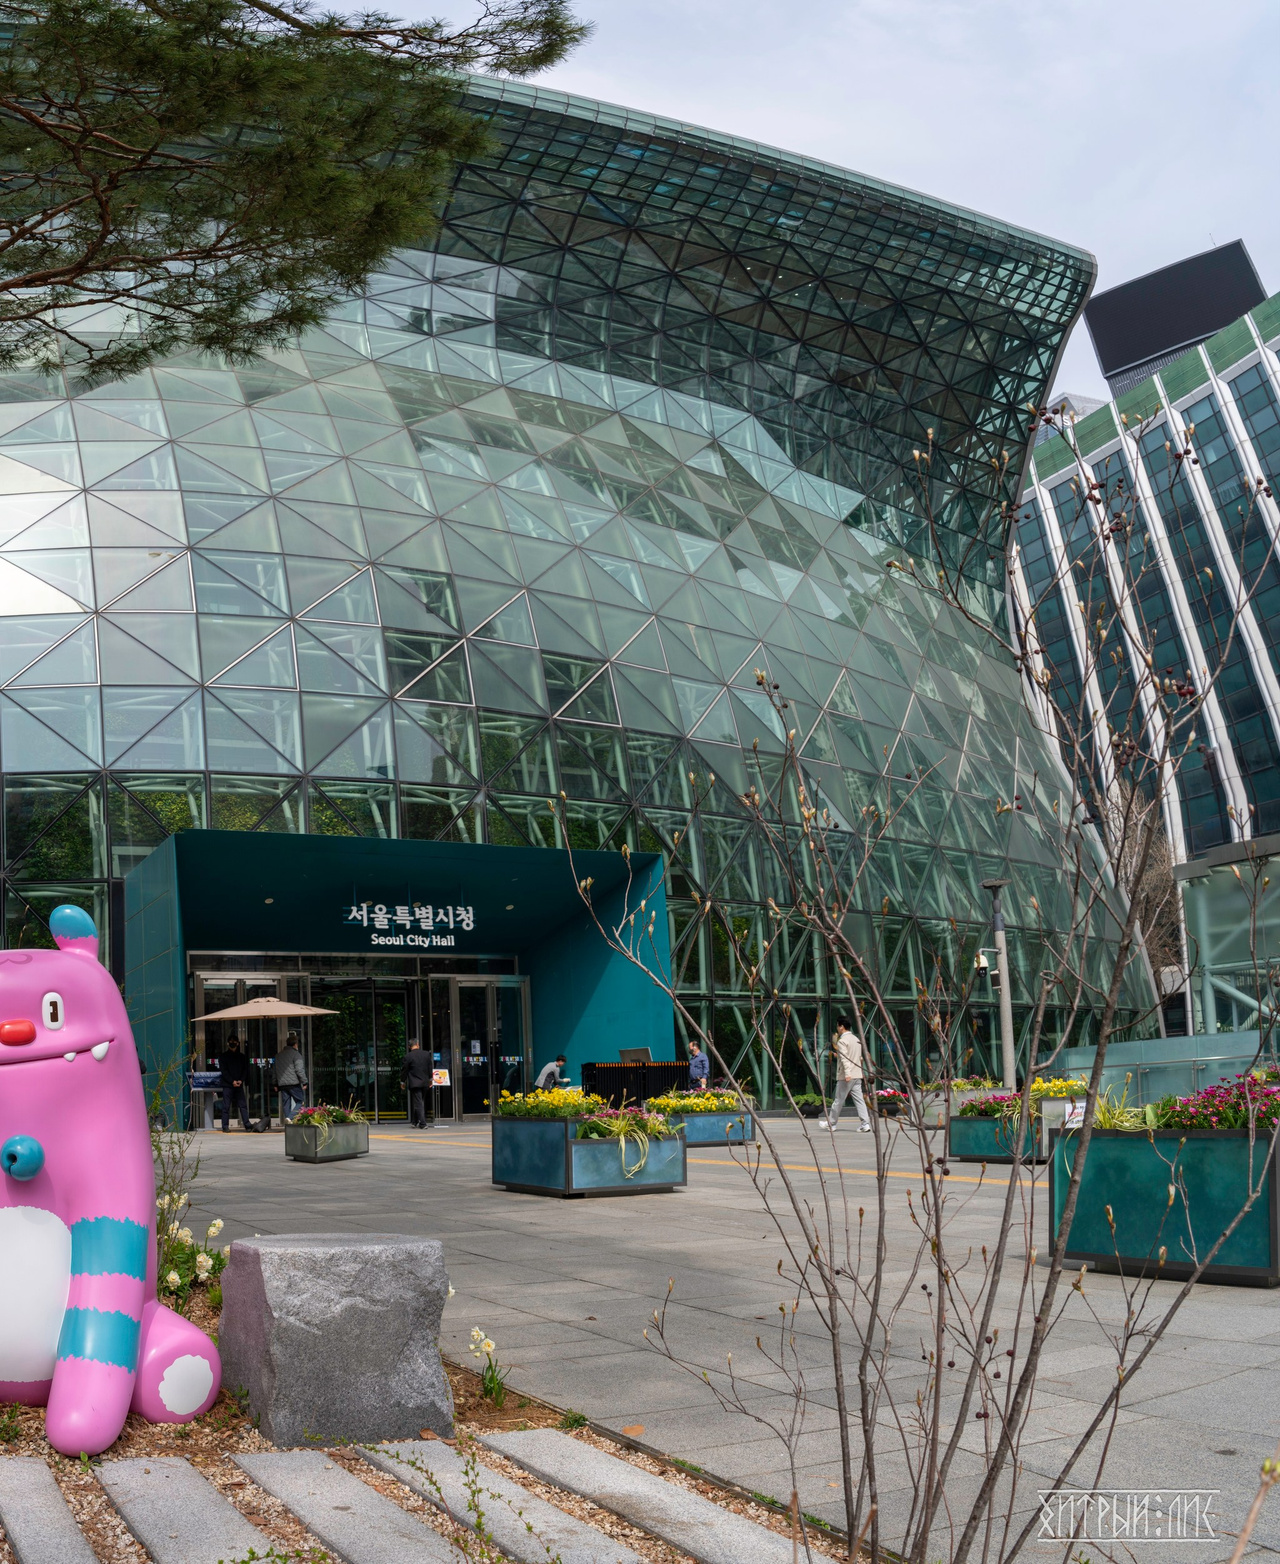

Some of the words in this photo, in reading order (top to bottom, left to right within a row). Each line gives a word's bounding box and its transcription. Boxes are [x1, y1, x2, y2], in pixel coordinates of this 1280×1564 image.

[348, 903, 475, 931] 서울특별시청
[371, 933, 404, 946] Seoul
[406, 934, 430, 947] City
[432, 934, 455, 946] Hall
